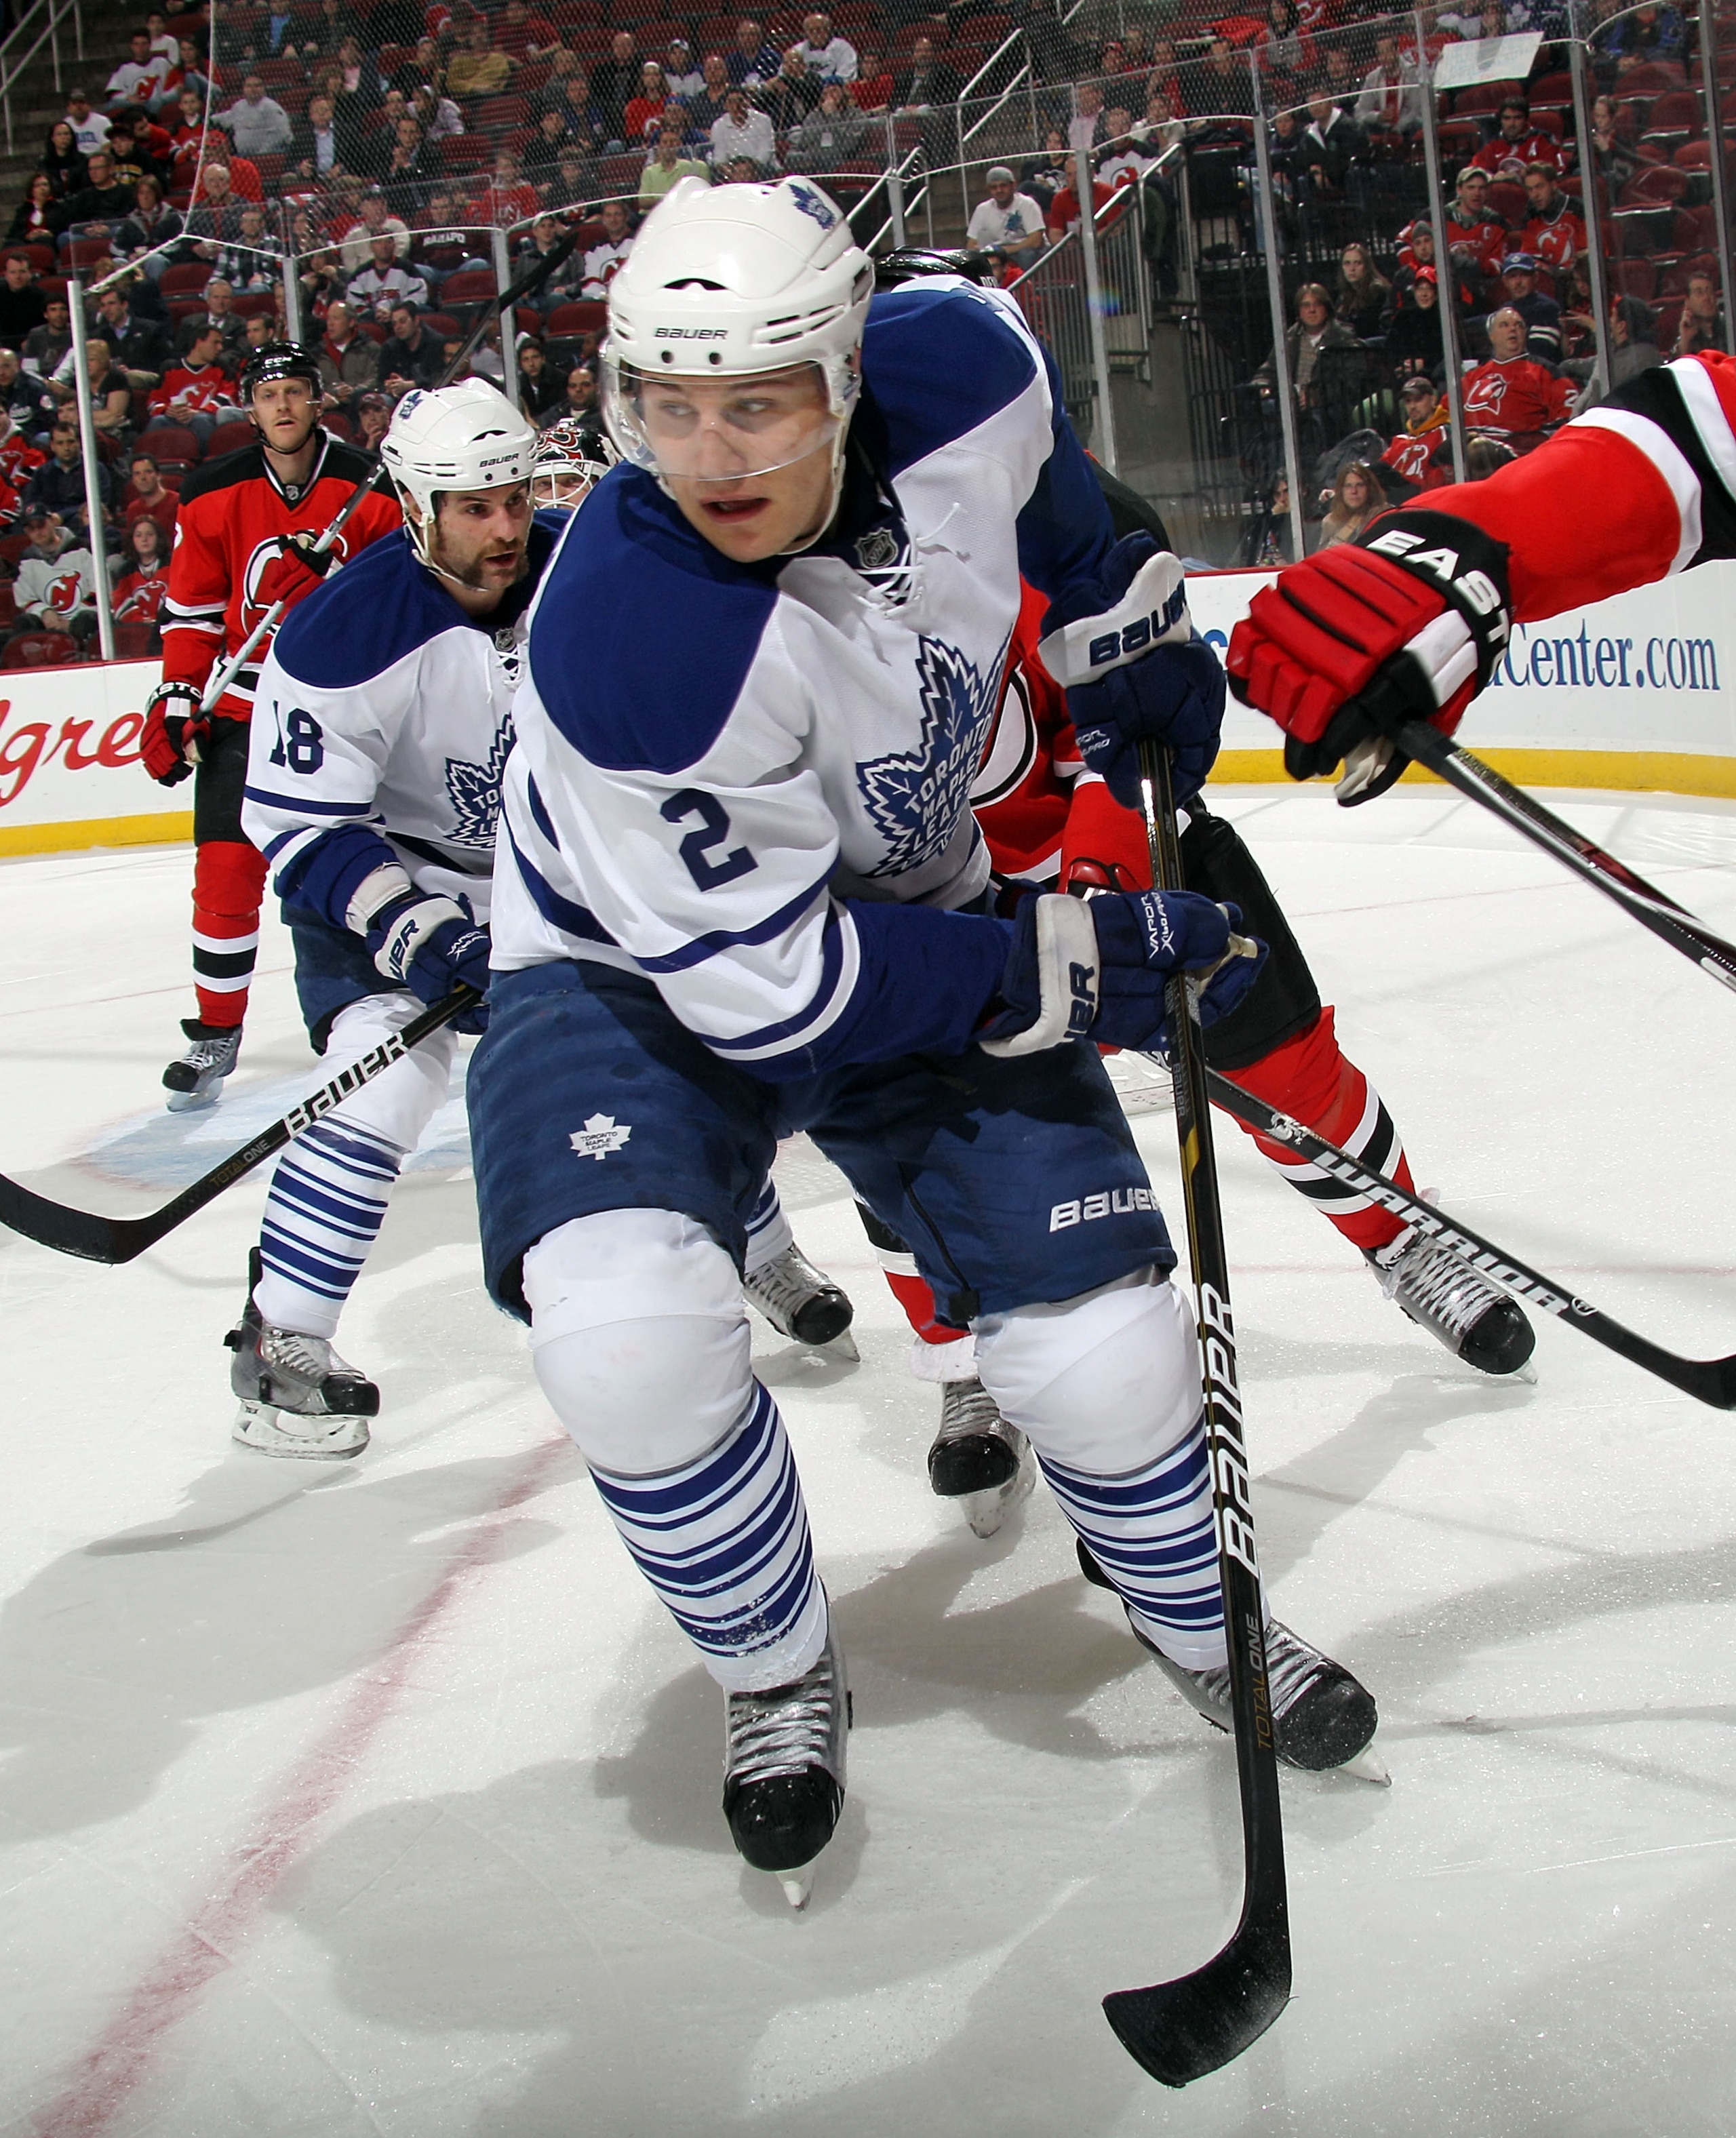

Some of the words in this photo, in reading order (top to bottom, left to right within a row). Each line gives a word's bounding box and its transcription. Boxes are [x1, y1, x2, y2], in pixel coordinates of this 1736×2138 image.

[654, 328, 728, 340] BAUER
[479, 452, 519, 468] BAUER
[269, 700, 323, 775] 18
[904, 712, 992, 814] TORONTO
[913, 771, 974, 852] LEAFS
[922, 749, 977, 825] MAPLE
[661, 789, 758, 892] 2
[1141, 893, 1159, 959] VAPOR
[283, 1032, 408, 1139] BAUER
[243, 1139, 271, 1164] ONE
[580, 1131, 618, 1142] TORONTO
[585, 1138, 612, 1147] MAPLE
[1313, 1151, 1569, 1315] WARRIOR
[1191, 1283, 1261, 1580] BAUER
[1246, 1613, 1263, 1671] ONE
[1253, 1672, 1272, 1749] TOTAL
